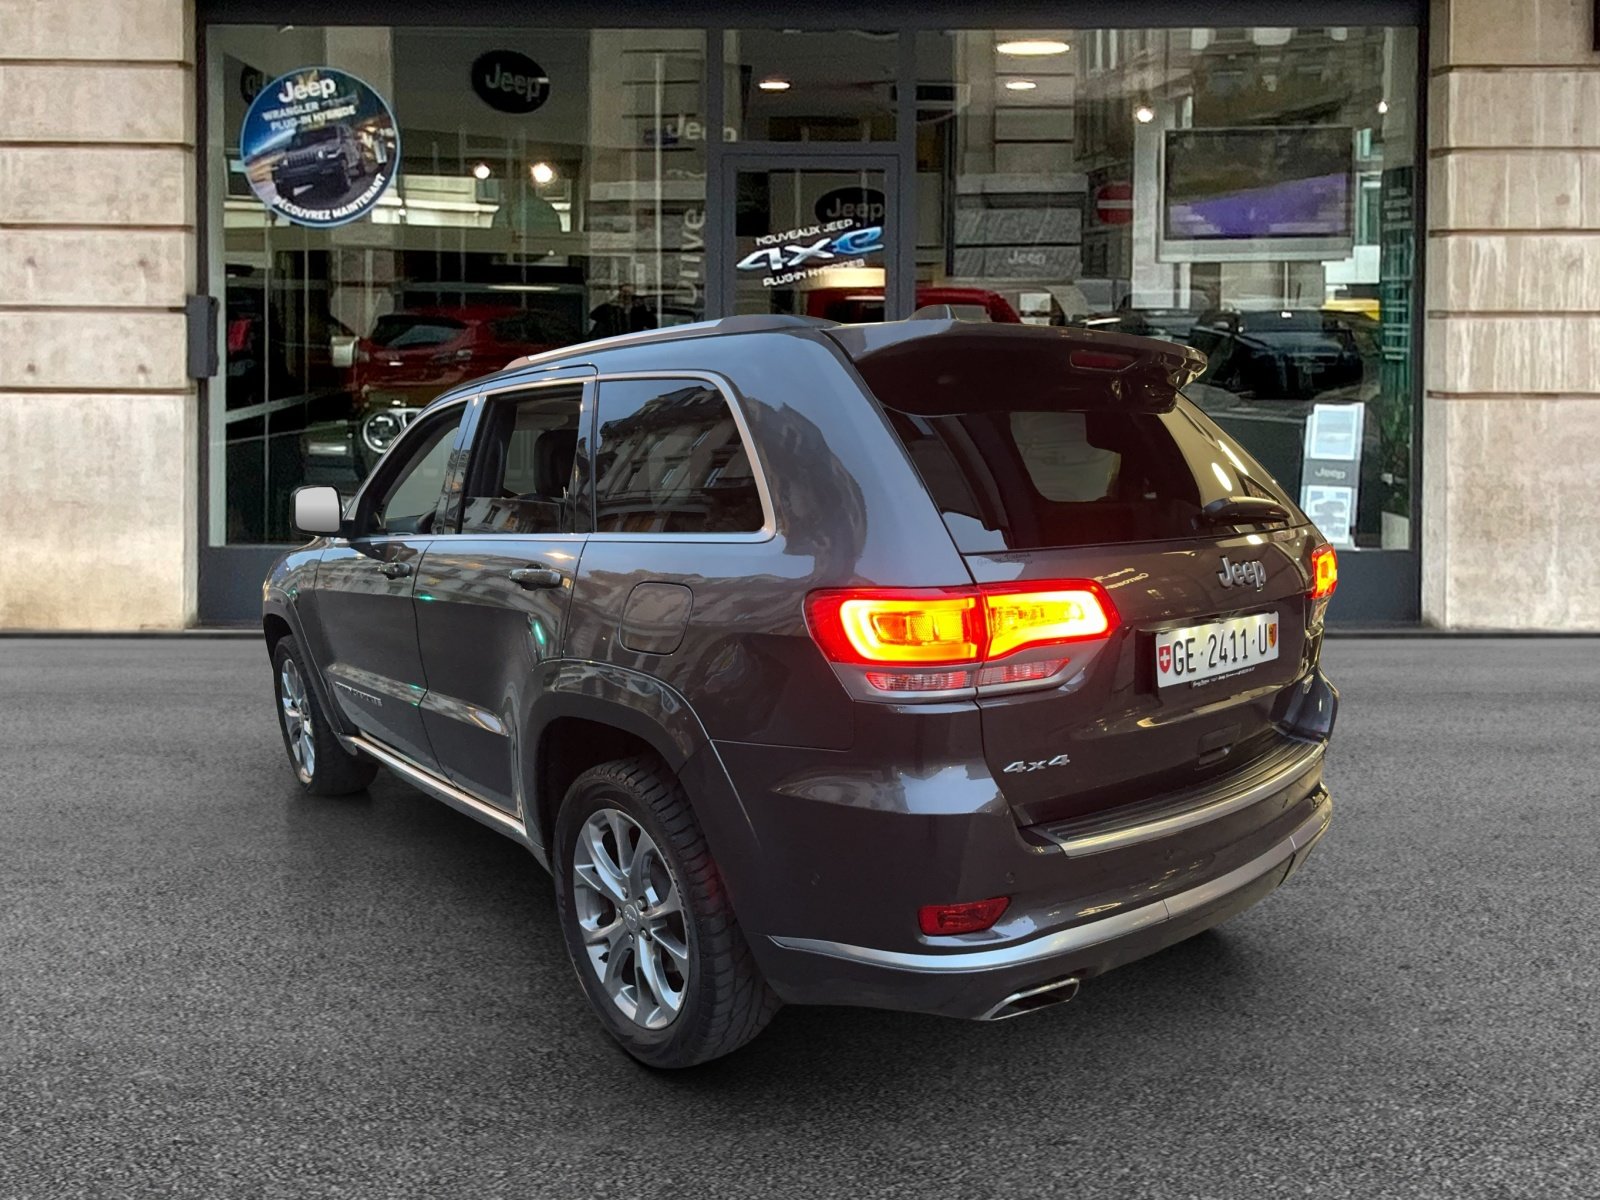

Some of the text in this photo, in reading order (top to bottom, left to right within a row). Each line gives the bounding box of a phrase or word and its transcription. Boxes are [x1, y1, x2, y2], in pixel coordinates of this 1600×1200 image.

[278, 78, 336, 103] Jeep
[485, 63, 541, 102] Jeep
[262, 101, 320, 121] WRANGLER
[666, 113, 737, 142] Jep
[332, 173, 386, 218] MAINTENANT
[826, 197, 885, 222] Jeep
[756, 223, 820, 246] NOUVEAUX
[1315, 468, 1346, 480] Jeep
[1218, 555, 1267, 592] Jeep
[1003, 754, 1071, 773] 4x4
